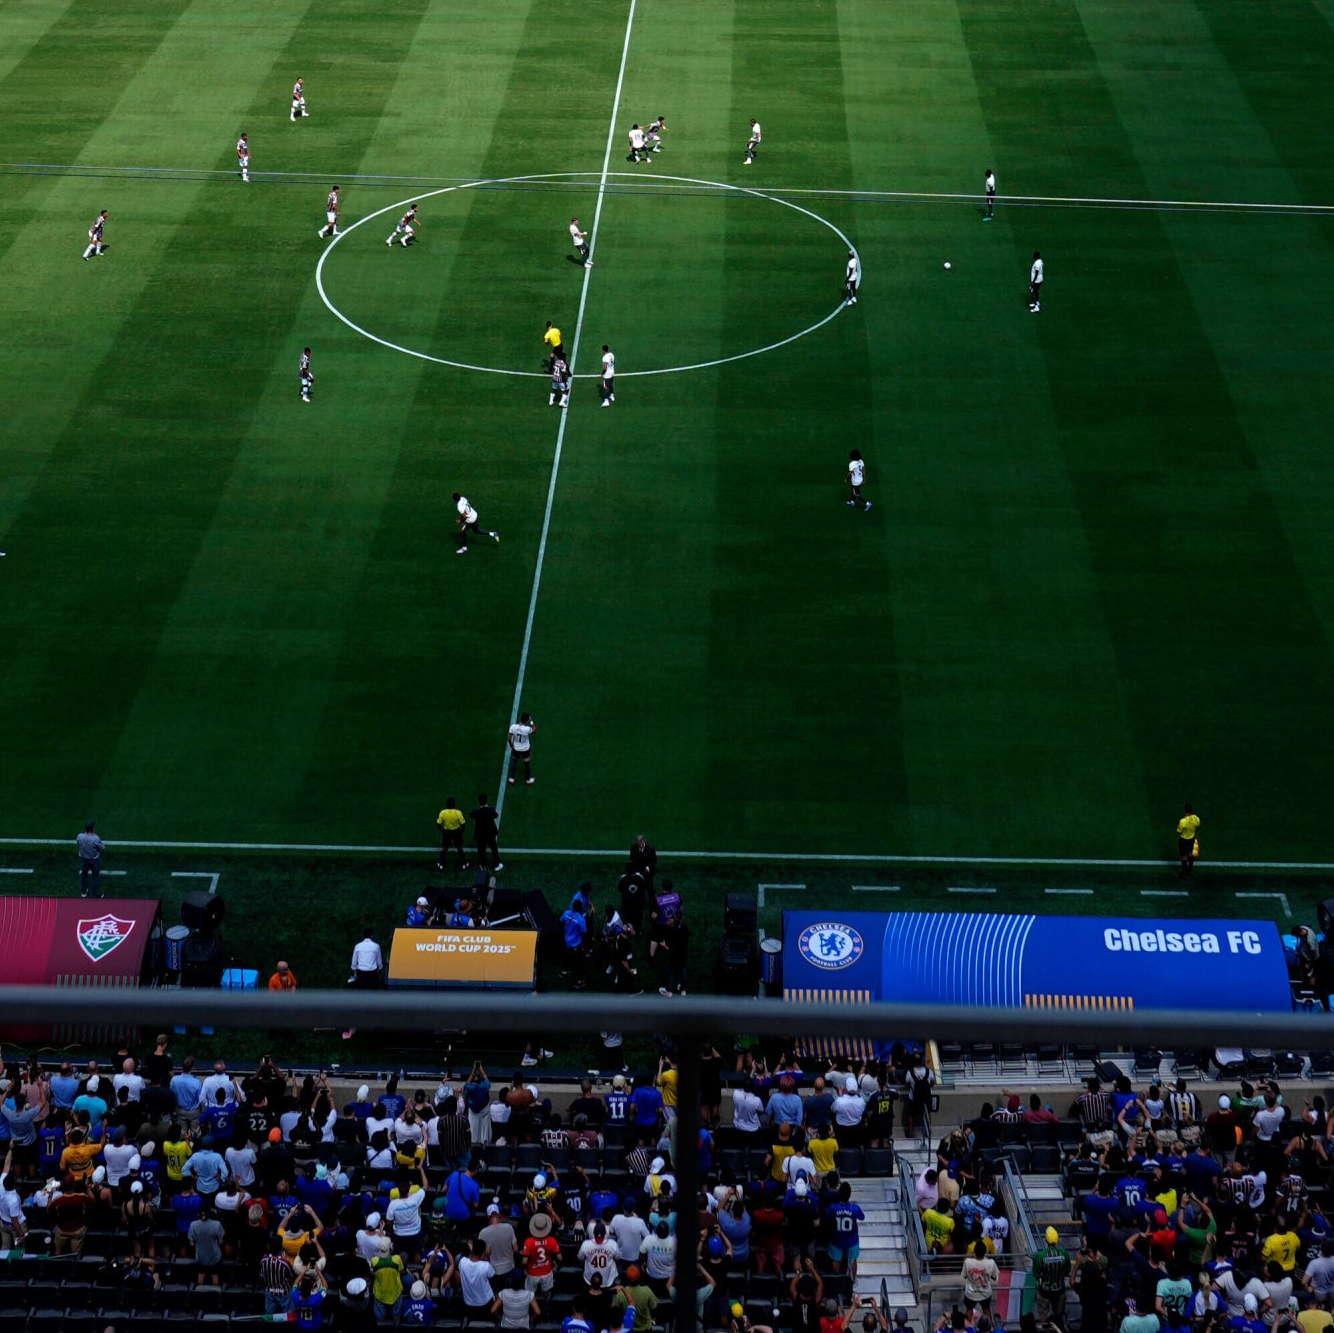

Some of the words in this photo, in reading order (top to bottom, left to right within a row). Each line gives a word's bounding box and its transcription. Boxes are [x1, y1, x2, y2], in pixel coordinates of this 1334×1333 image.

[809, 922, 851, 936] CHELSEA
[437, 935, 461, 943] FIFA
[462, 935, 492, 944] CLUB
[1104, 927, 1219, 954] Chelsea
[1226, 929, 1261, 955] FC
[416, 943, 456, 952] WORLD
[458, 944, 481, 953] CUP
[809, 954, 838, 969] FOOTBALL
[609, 1102, 625, 1119] 11
[1124, 1191, 1140, 1207] 10
[836, 1217, 853, 1232] 10
[537, 1247, 546, 1263] 3
[590, 1255, 607, 1269] 40
